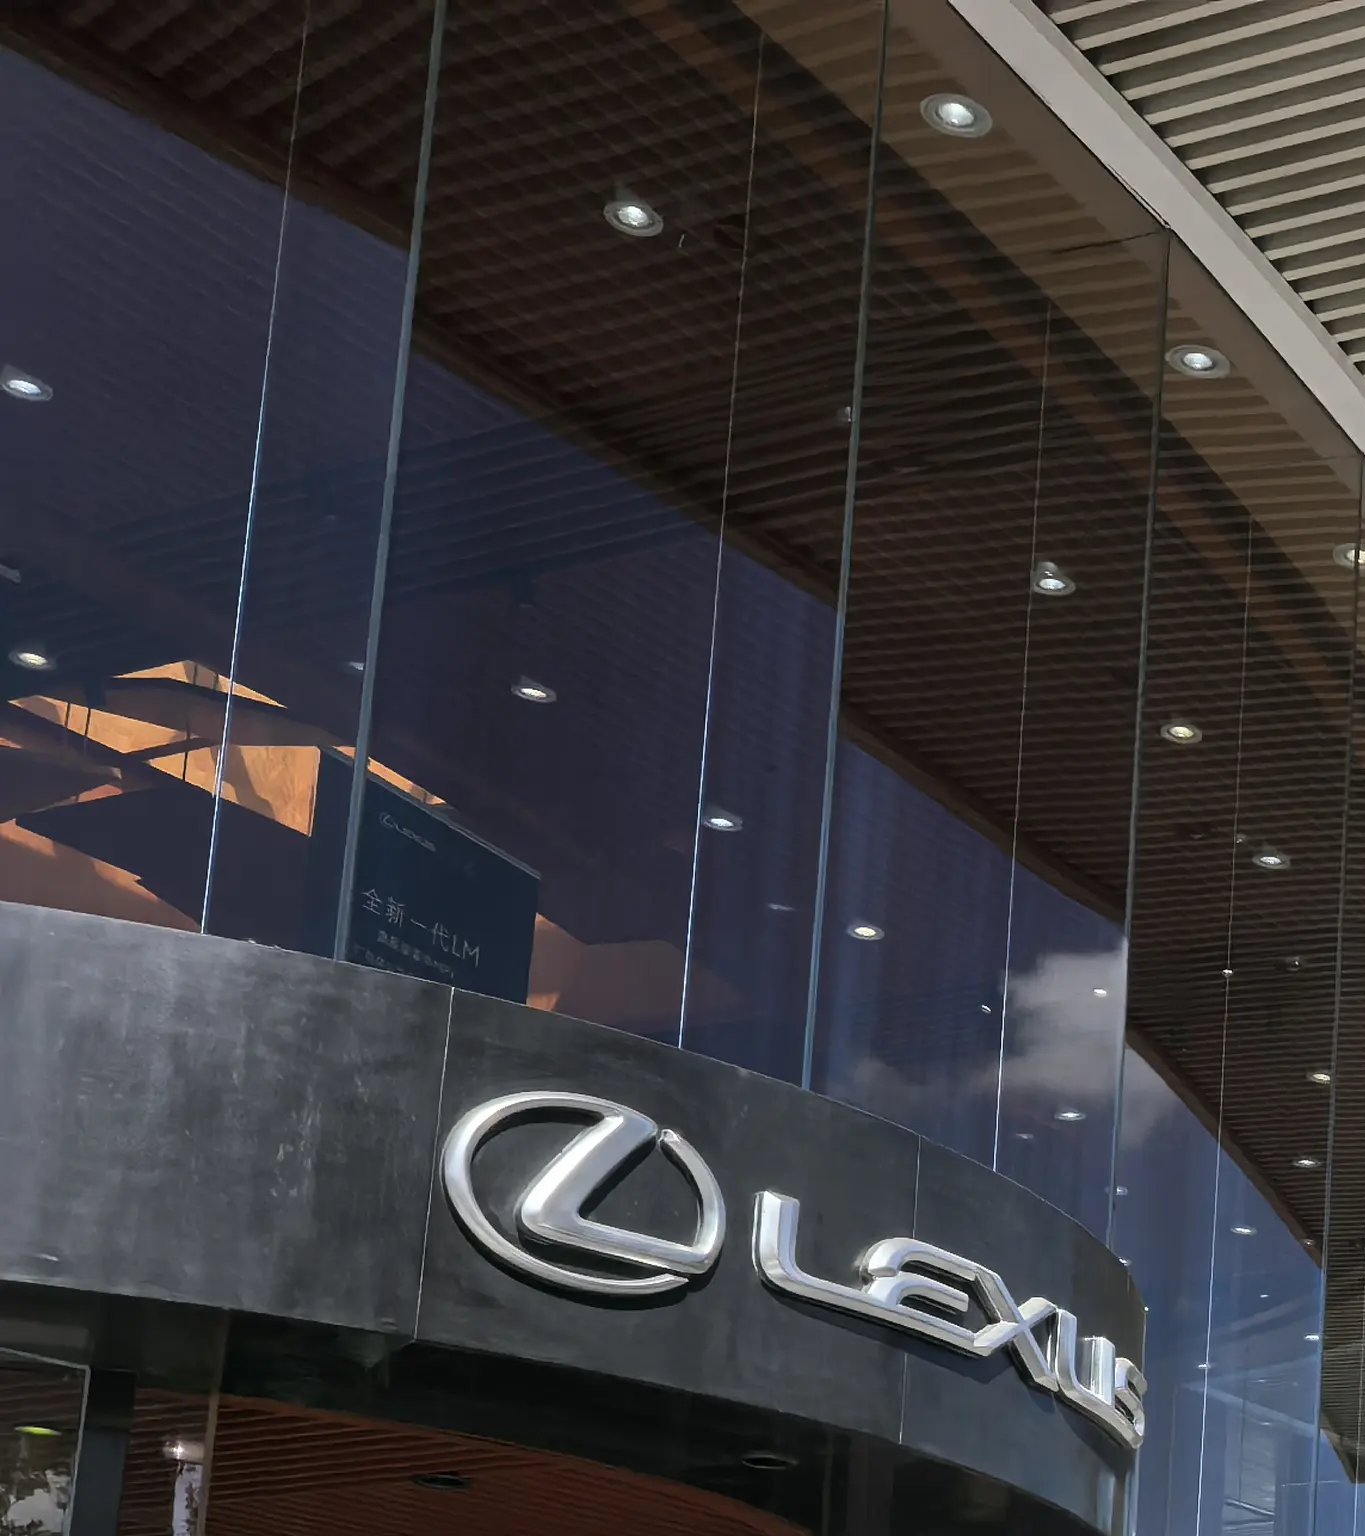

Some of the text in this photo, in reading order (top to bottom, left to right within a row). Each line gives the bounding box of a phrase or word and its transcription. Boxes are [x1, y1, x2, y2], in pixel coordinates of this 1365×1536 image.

[362, 889, 480, 967] 全新一代LM
[752, 1190, 1146, 1449] LEXUS
